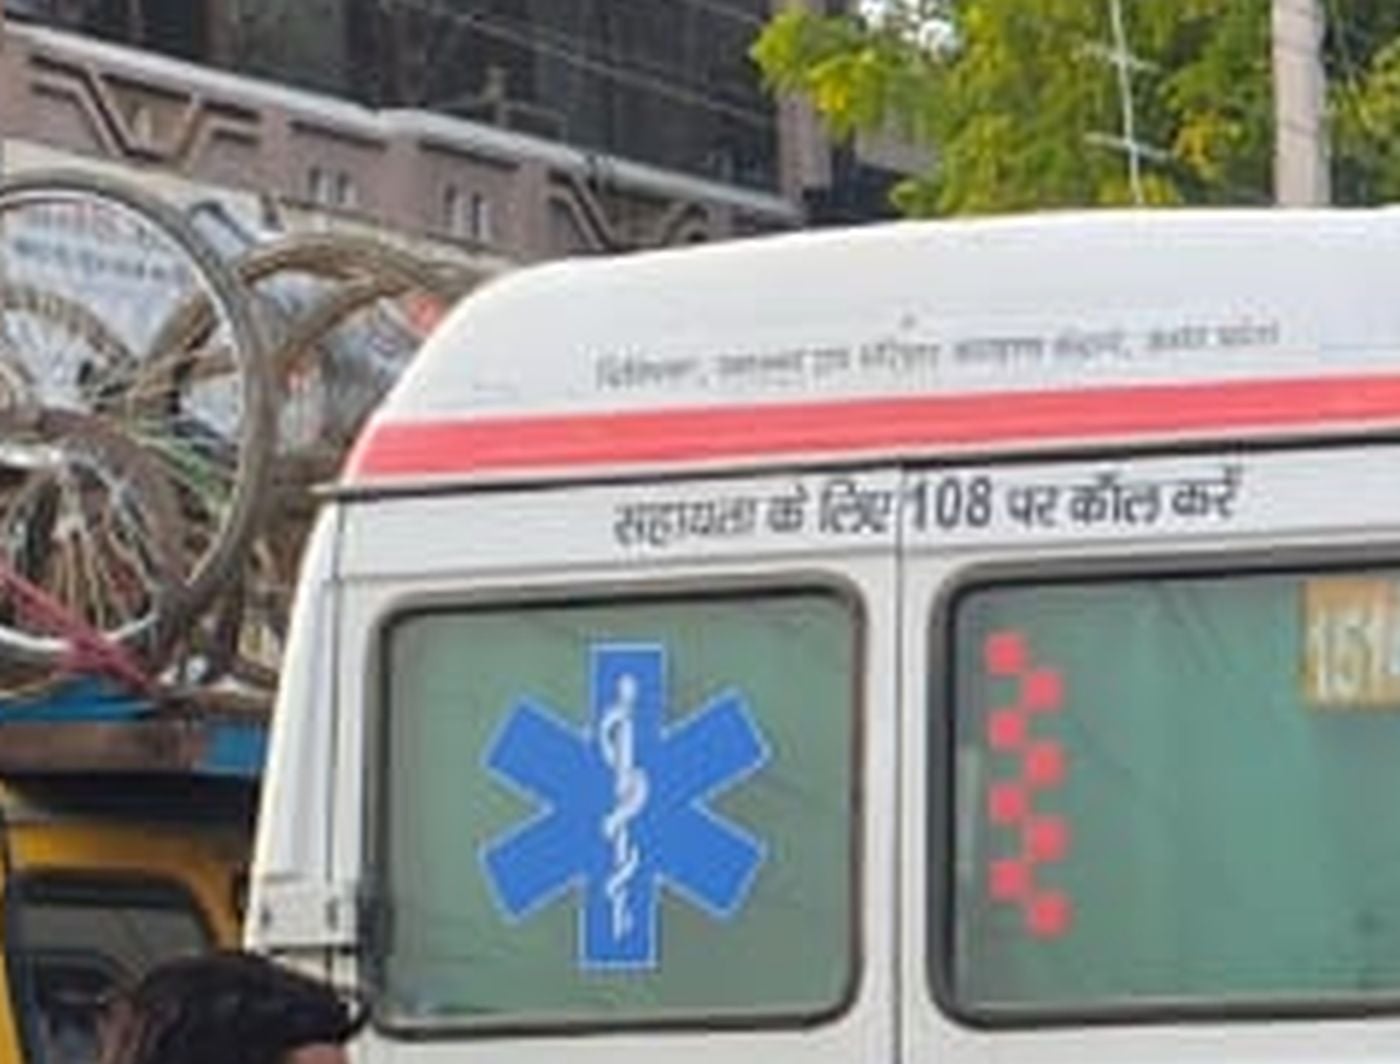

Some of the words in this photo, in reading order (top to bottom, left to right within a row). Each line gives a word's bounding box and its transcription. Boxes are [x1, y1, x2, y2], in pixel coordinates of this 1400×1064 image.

[612, 493, 755, 548] सहायता
[817, 478, 892, 536] लिए
[909, 474, 993, 532] 108
[1006, 487, 1057, 527] पर
